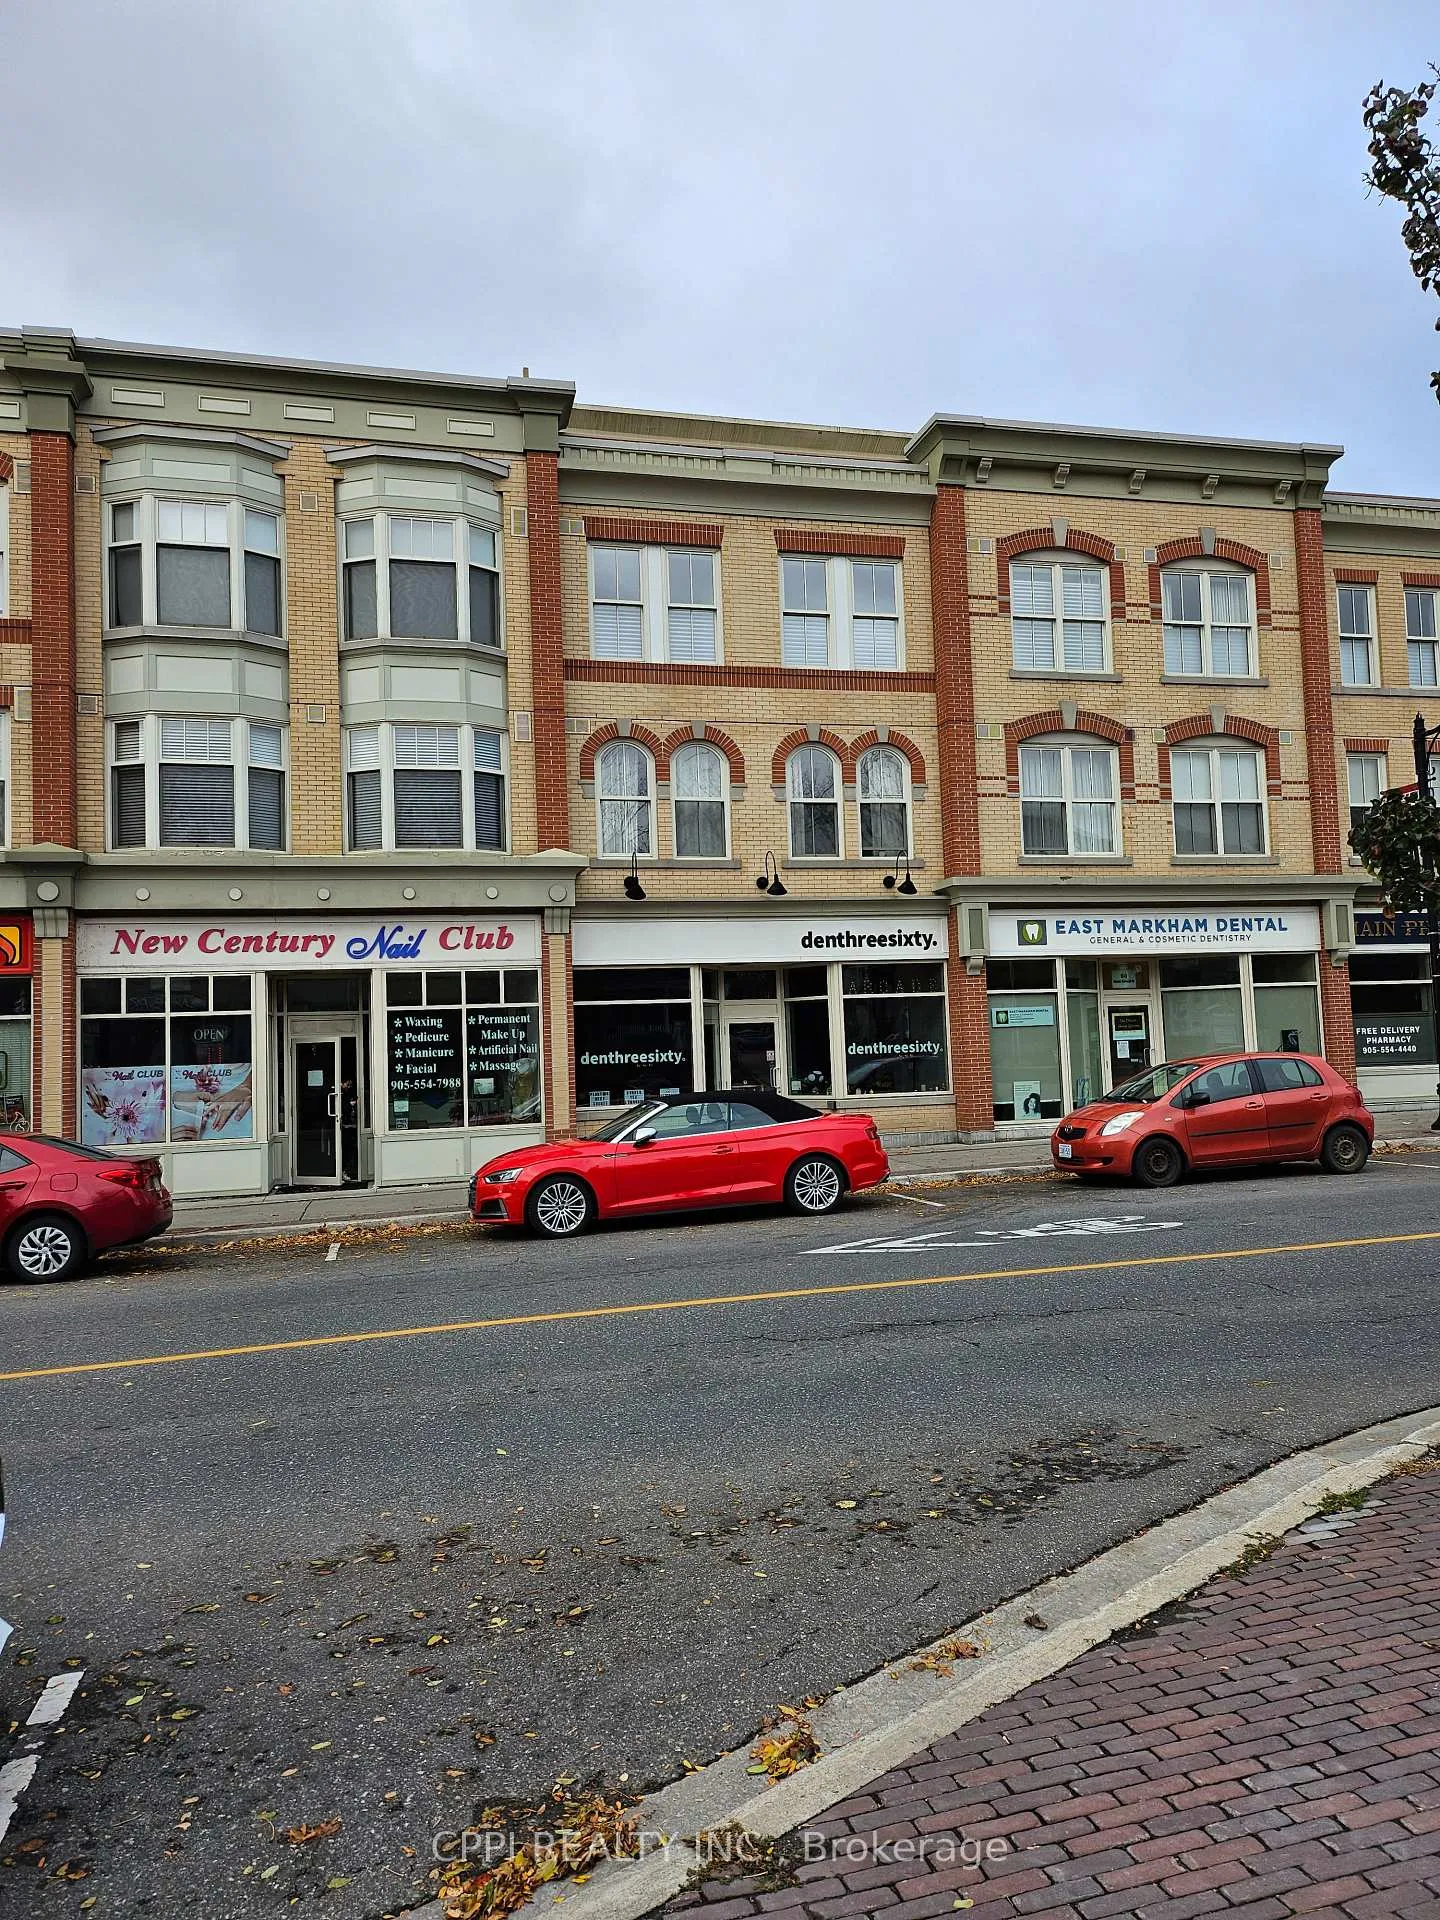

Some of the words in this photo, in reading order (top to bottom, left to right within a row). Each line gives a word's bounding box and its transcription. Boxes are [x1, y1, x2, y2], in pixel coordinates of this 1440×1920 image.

[1055, 920, 1104, 934] EAST
[1112, 918, 1208, 933] MARKHAM
[1216, 917, 1288, 932] DENTAL
[110, 929, 188, 954] New
[197, 928, 336, 958] Century
[346, 925, 428, 959] Nail
[438, 925, 514, 950] Club
[801, 929, 938, 950] denthreesixty.
[1089, 936, 1135, 944] GENERAL
[1148, 935, 1197, 943] COSMETIC
[1200, 934, 1252, 942] DENTISTRY
[405, 1016, 443, 1028] Waxing
[478, 1013, 530, 1024] Permanent
[193, 1028, 225, 1041] OPEN
[481, 1029, 509, 1040] Make
[511, 1028, 526, 1041] Up
[1356, 1027, 1378, 1035] FREE
[1380, 1025, 1420, 1034] DELIVERY
[405, 1032, 449, 1043] Pedicure
[1366, 1035, 1412, 1044] PHARMACY
[405, 1047, 455, 1058] Manicure
[478, 1044, 517, 1056] Artificial
[519, 1043, 538, 1054] Nail
[1362, 1045, 1417, 1054] 905-554-4440
[136, 1069, 164, 1079] CLUB
[206, 1069, 232, 1078] CLUB
[406, 1063, 437, 1074] Facial
[390, 1077, 461, 1091] 905-554-7988
